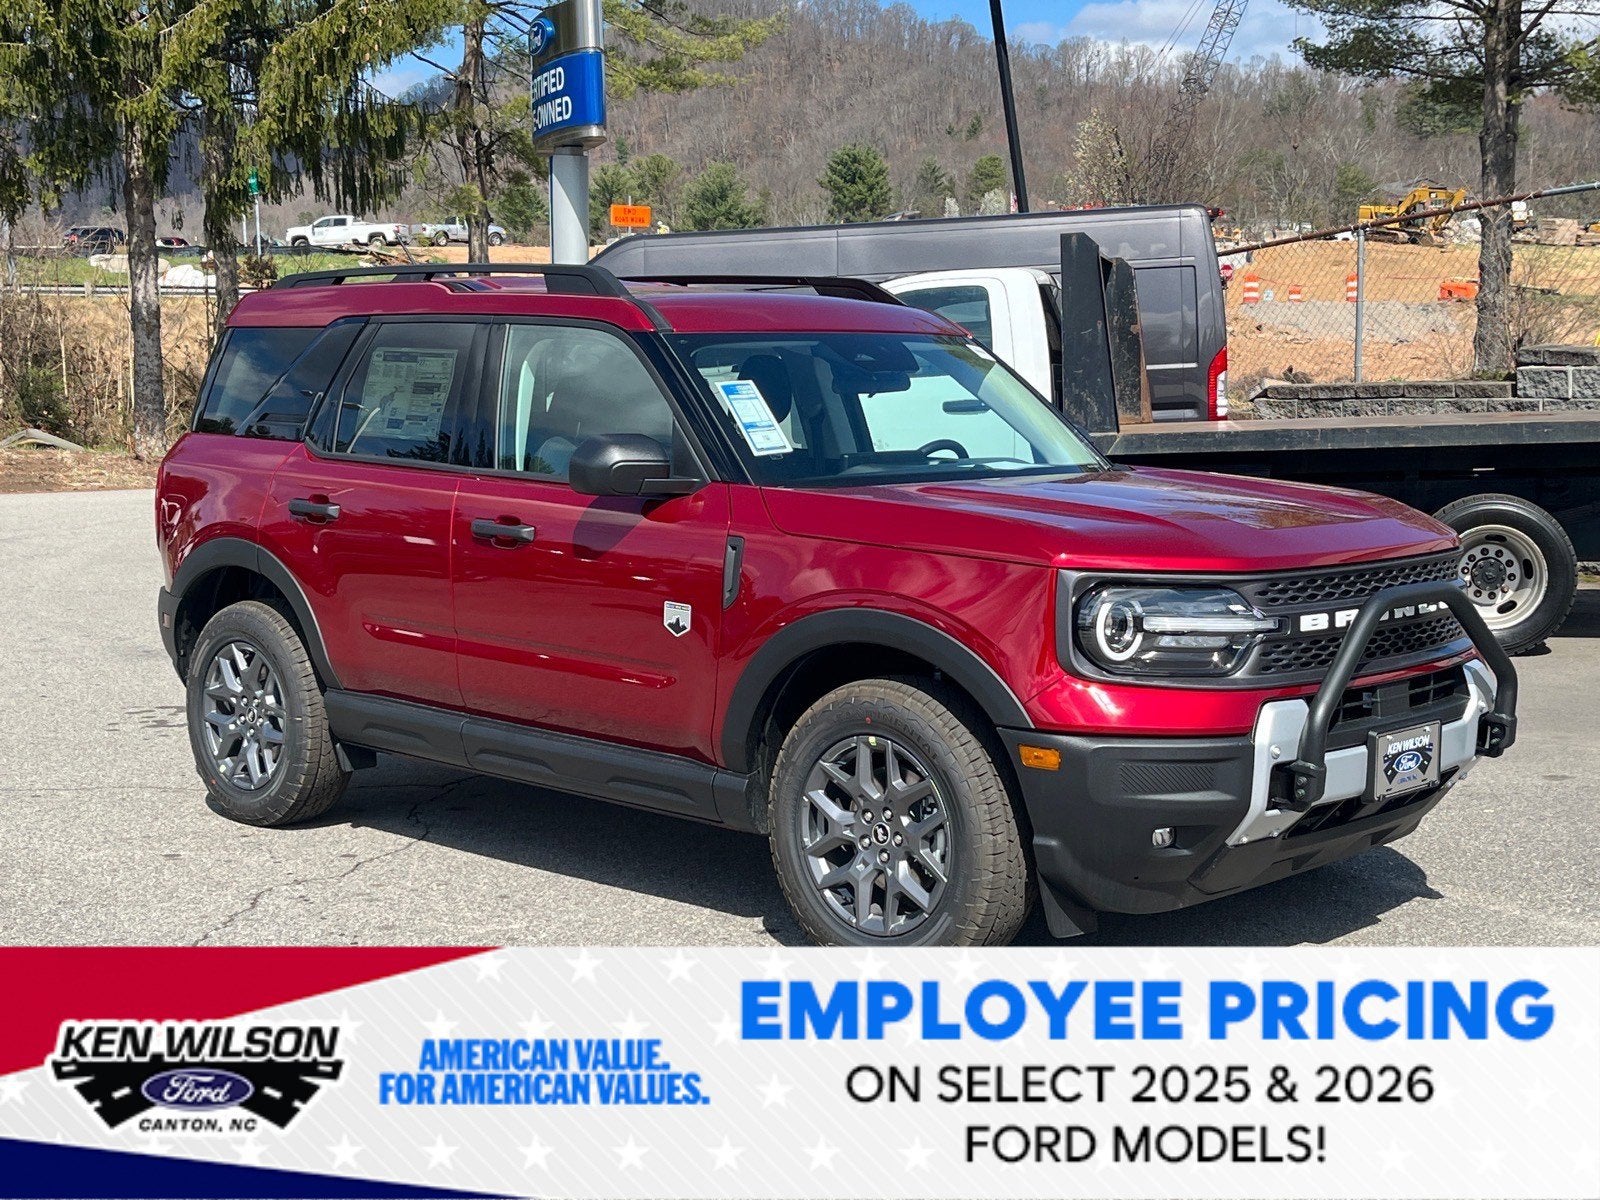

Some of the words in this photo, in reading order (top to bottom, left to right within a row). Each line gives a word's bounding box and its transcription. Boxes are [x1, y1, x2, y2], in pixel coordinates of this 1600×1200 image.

[1387, 741, 1403, 755] KEN
[1403, 734, 1431, 751] WILSON
[1400, 754, 1418, 771] Ford
